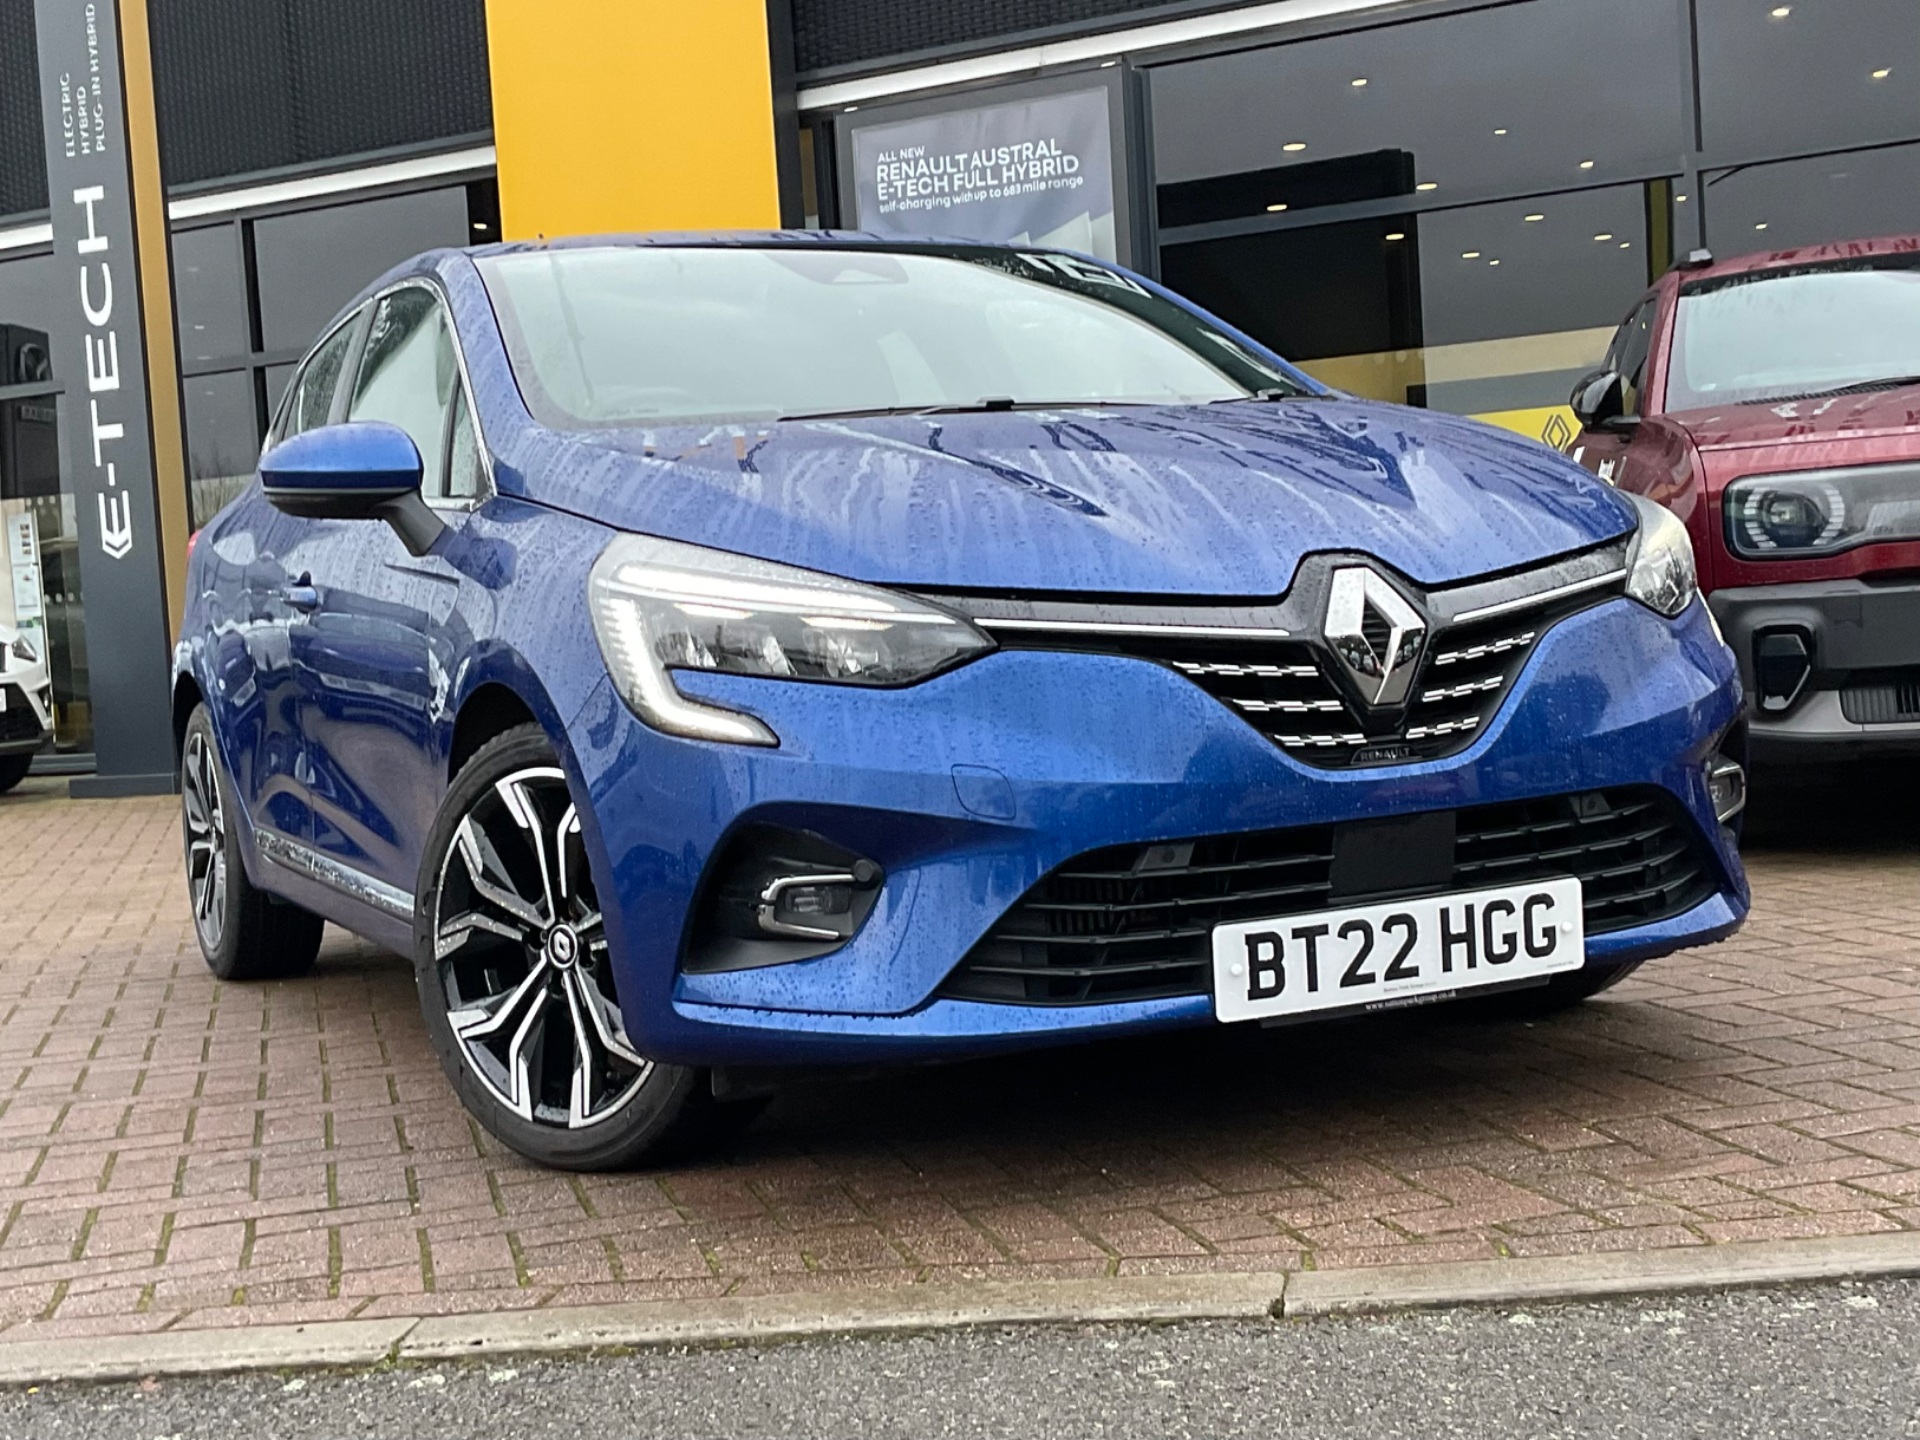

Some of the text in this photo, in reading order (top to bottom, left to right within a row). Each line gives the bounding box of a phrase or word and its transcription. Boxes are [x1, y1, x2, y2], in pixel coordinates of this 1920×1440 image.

[85, 3, 106, 152] PLUG-IN HYBRID
[60, 72, 75, 157] ELECTRIC
[77, 86, 90, 154] HYBRID
[877, 145, 925, 163] ALL NEW
[877, 138, 1062, 182] RENAULT AUSTRAL
[877, 155, 1079, 201] E-TECH FULL HYBRID
[879, 195, 951, 214] self-charging
[952, 191, 973, 205] with
[974, 189, 987, 202] up
[989, 188, 1001, 198] to
[1022, 180, 1046, 193] mile
[1048, 176, 1084, 190] range
[74, 185, 132, 559] E-TECH
[1360, 747, 1410, 762] RENAULT
[1244, 892, 1557, 1002] BT22 HGG
